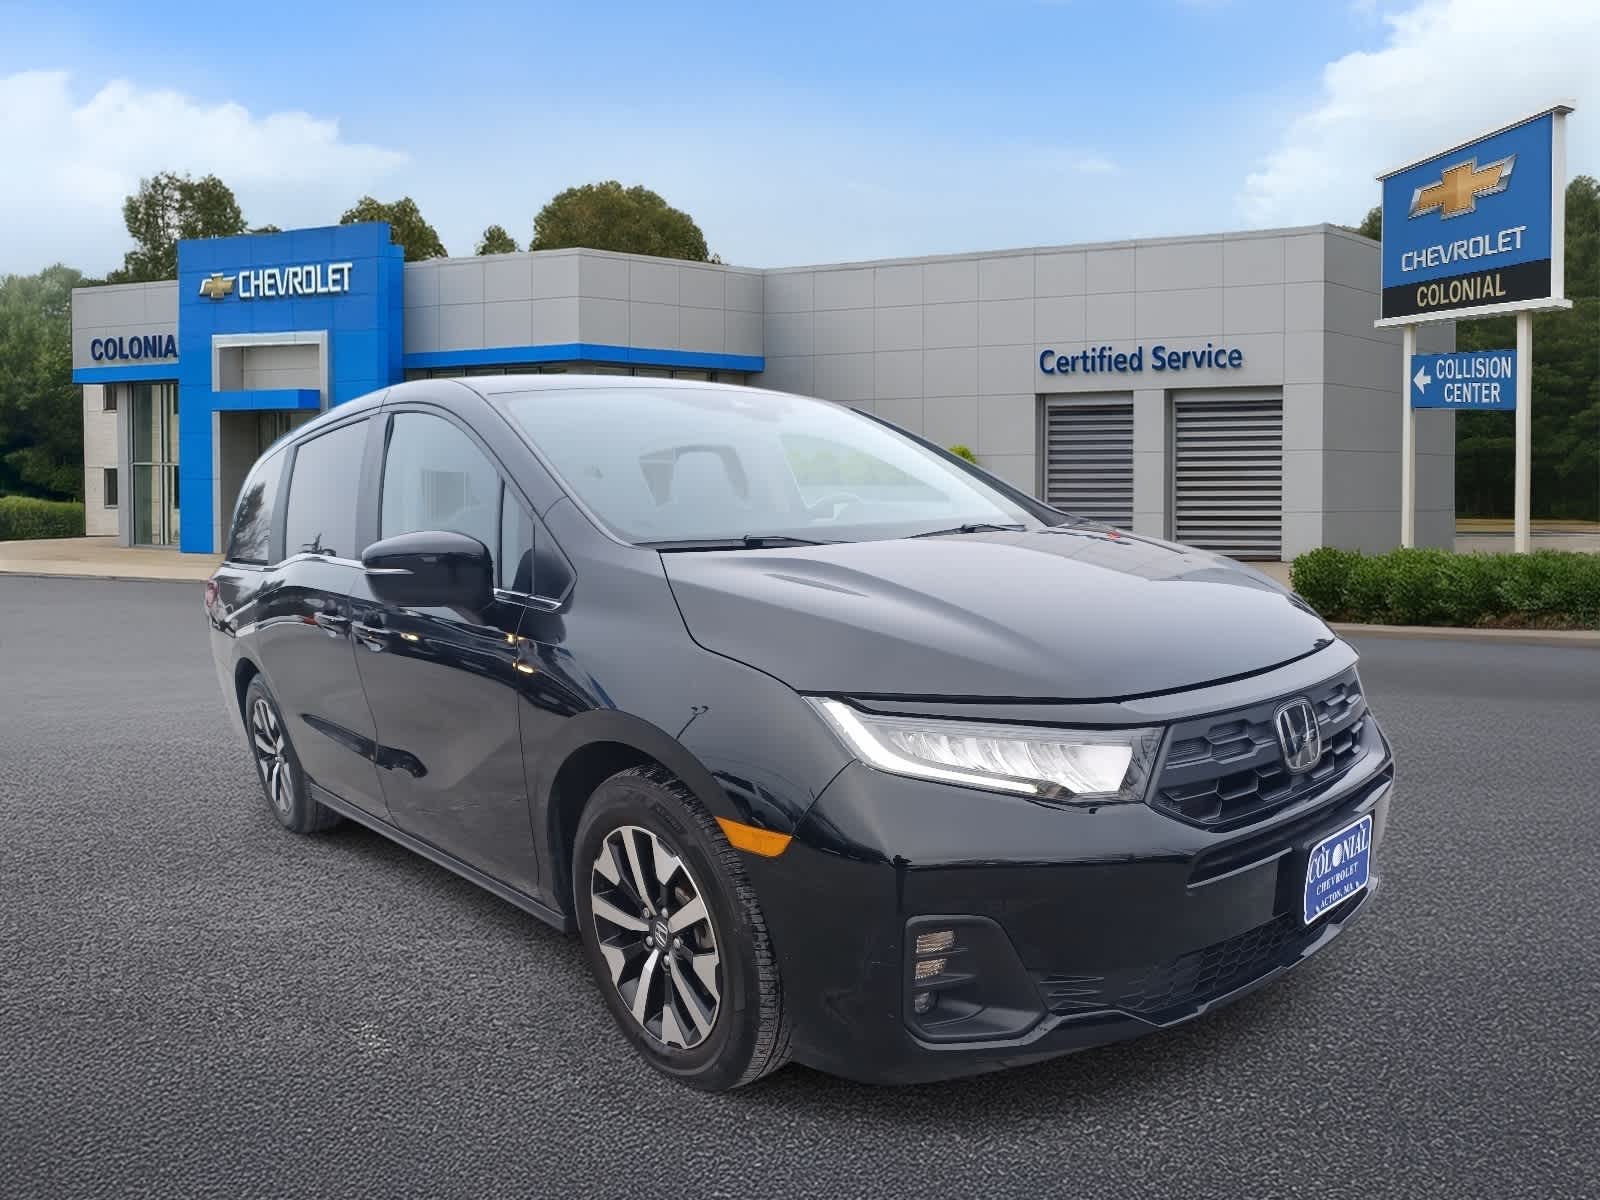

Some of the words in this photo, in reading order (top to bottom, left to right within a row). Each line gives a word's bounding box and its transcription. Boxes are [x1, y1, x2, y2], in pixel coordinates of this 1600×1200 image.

[1402, 225, 1527, 272] CHEVROLET
[238, 261, 353, 299] CHEVROLET
[1416, 273, 1506, 307] COLONIAL
[91, 334, 179, 361] COLONIA
[1039, 346, 1144, 375] Certified
[1151, 343, 1243, 371] Service
[1436, 356, 1512, 379] COLLISION
[1444, 382, 1501, 403] CENTER
[1309, 828, 1368, 884] COLONIAL
[1316, 861, 1359, 896] CHEVROLET
